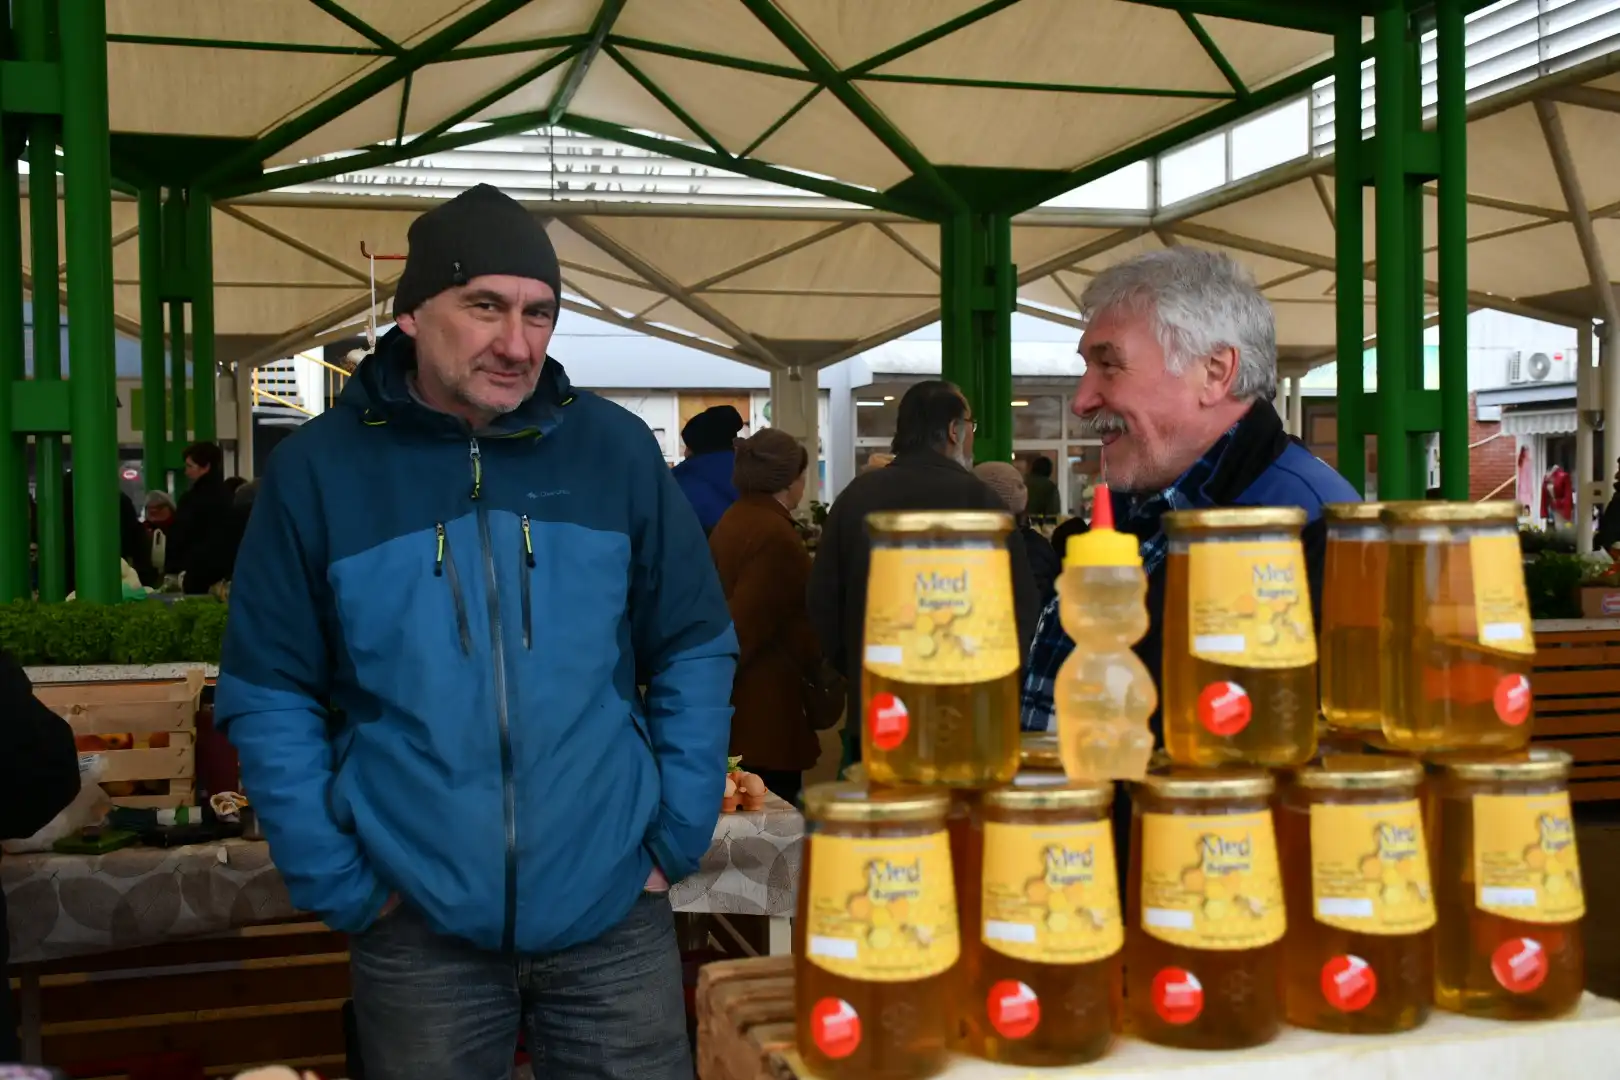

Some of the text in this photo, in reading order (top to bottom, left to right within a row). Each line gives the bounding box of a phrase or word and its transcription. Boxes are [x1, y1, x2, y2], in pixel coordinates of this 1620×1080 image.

[915, 569, 968, 593] Med
[1251, 562, 1296, 585] Med
[1046, 843, 1095, 869] Med
[1202, 831, 1250, 857] Med
[868, 857, 921, 883] Med
